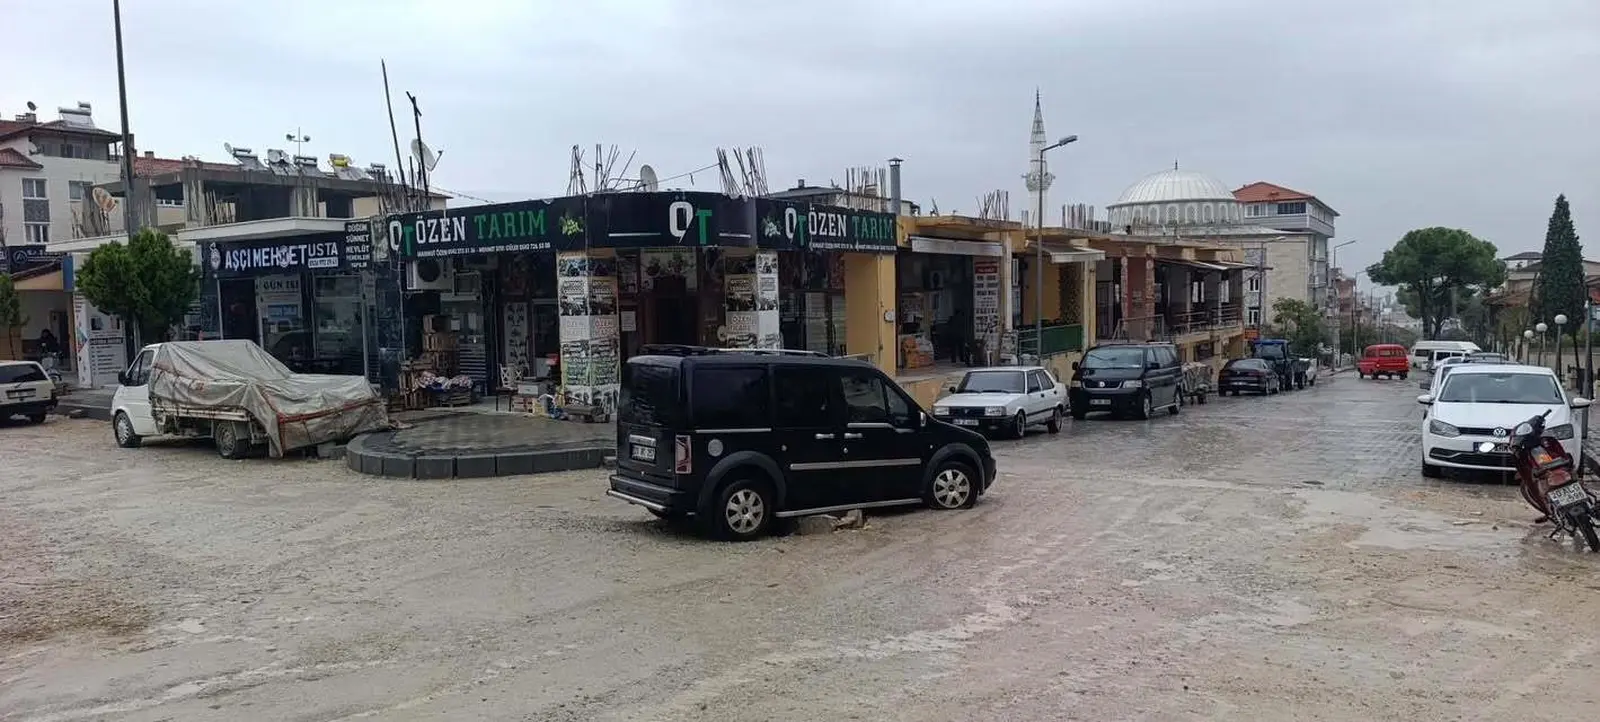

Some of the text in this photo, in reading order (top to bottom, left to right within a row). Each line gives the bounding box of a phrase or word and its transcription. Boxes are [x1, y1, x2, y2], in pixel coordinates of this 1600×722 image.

[415, 215, 466, 244] ÖZEN
[473, 209, 546, 240] TARIM
[808, 207, 847, 237] ÖZEN
[851, 215, 893, 240] TARIM
[225, 242, 338, 271] AŞÇI MEHET USTA
